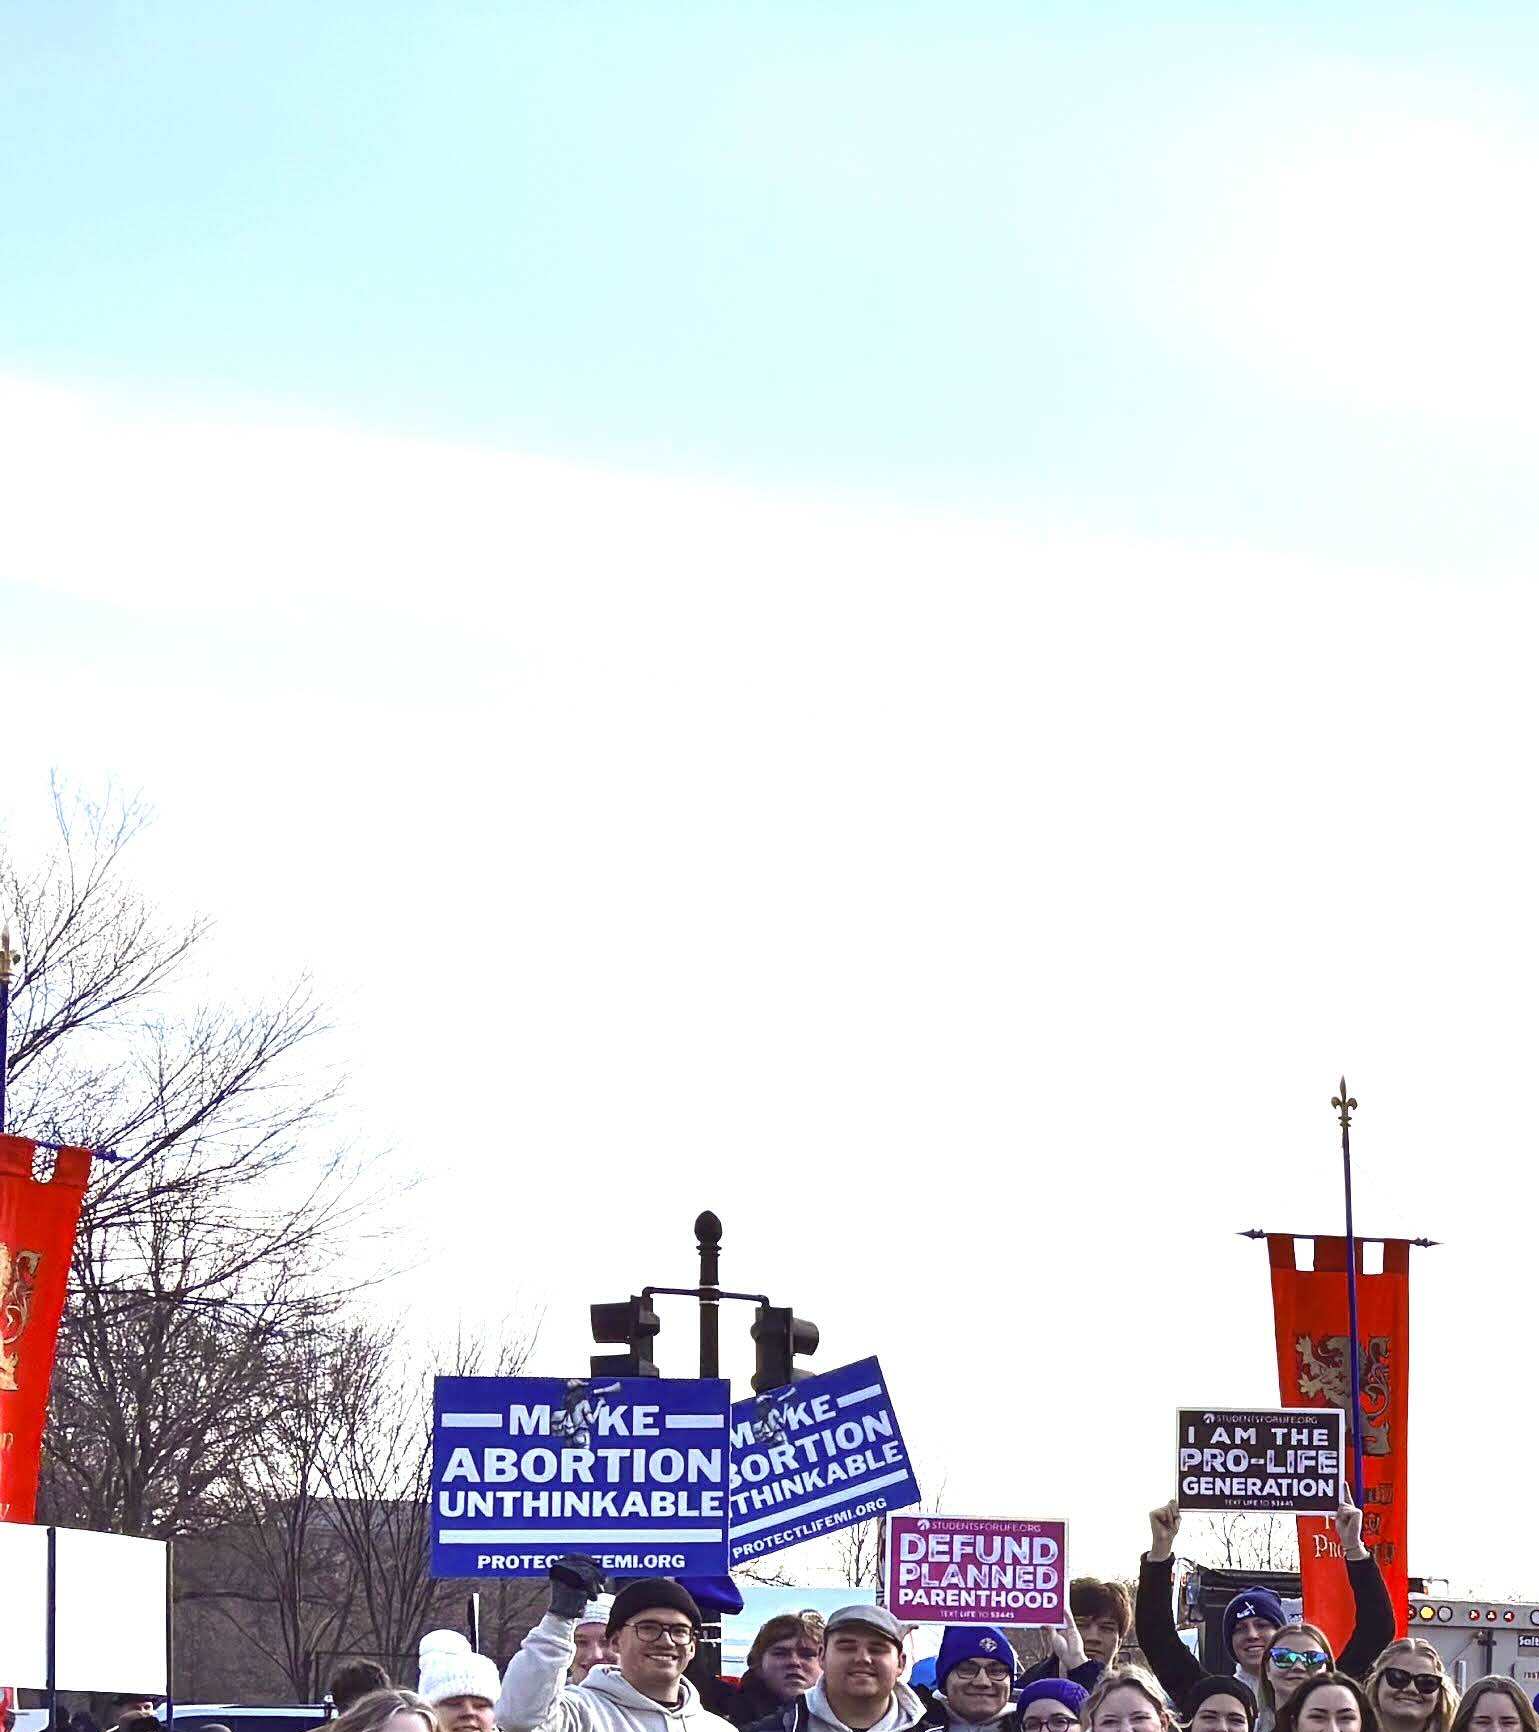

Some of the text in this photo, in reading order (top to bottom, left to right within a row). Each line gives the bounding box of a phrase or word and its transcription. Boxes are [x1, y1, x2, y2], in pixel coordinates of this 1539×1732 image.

[509, 1404, 660, 1436] MKE
[1216, 1414, 1317, 1424] STUDENTSFORLIFE.ORG
[1188, 1426, 1328, 1446] I AM THE
[441, 1448, 722, 1483] ABORTION
[1179, 1448, 1338, 1474] PRO-LIFE
[1182, 1477, 1334, 1497] GENERATION
[439, 1491, 724, 1517] UNTHINKABLE
[732, 1498, 887, 1558] PROTECTLIFEMI.ORG
[931, 1520, 1041, 1532] STUDENTSFORLIFE.ORG
[900, 1533, 1058, 1565] DEFUND
[899, 1562, 1058, 1589] PLANNED
[898, 1589, 1058, 1608] PARENTHOOD
